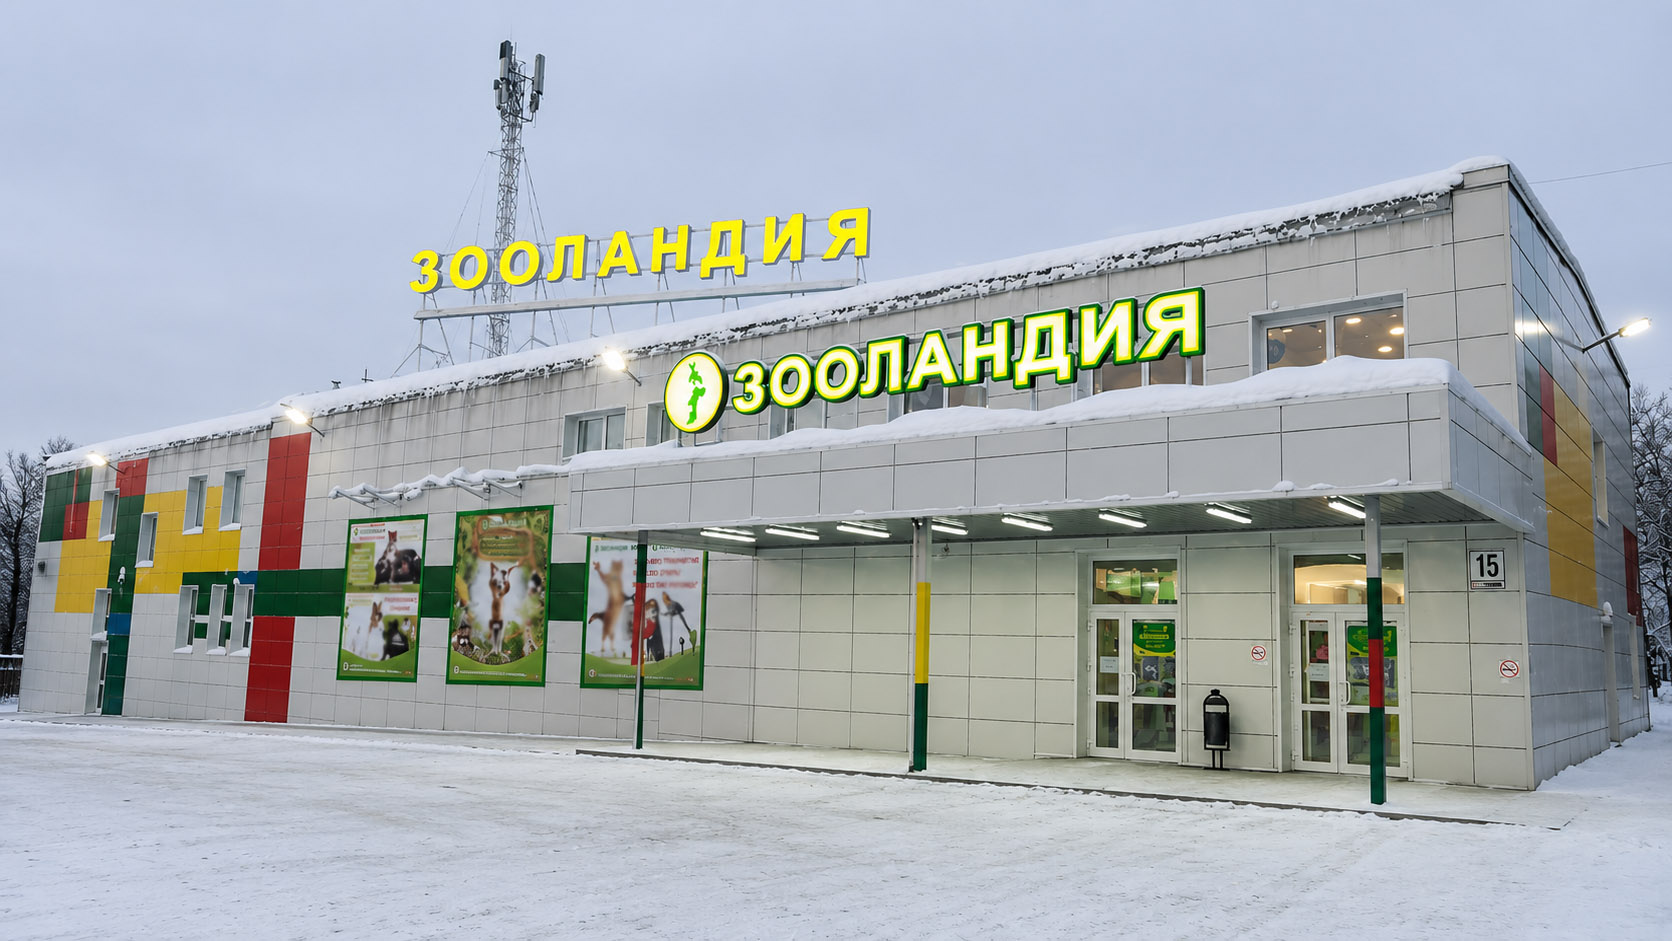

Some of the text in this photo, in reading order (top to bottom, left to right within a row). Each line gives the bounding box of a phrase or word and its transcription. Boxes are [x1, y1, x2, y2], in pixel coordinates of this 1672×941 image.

[409, 206, 871, 294] ЗООЛАНДИЯ
[731, 286, 1206, 416] ЗООЛАНДИЯ
[1476, 553, 1499, 578] 15
